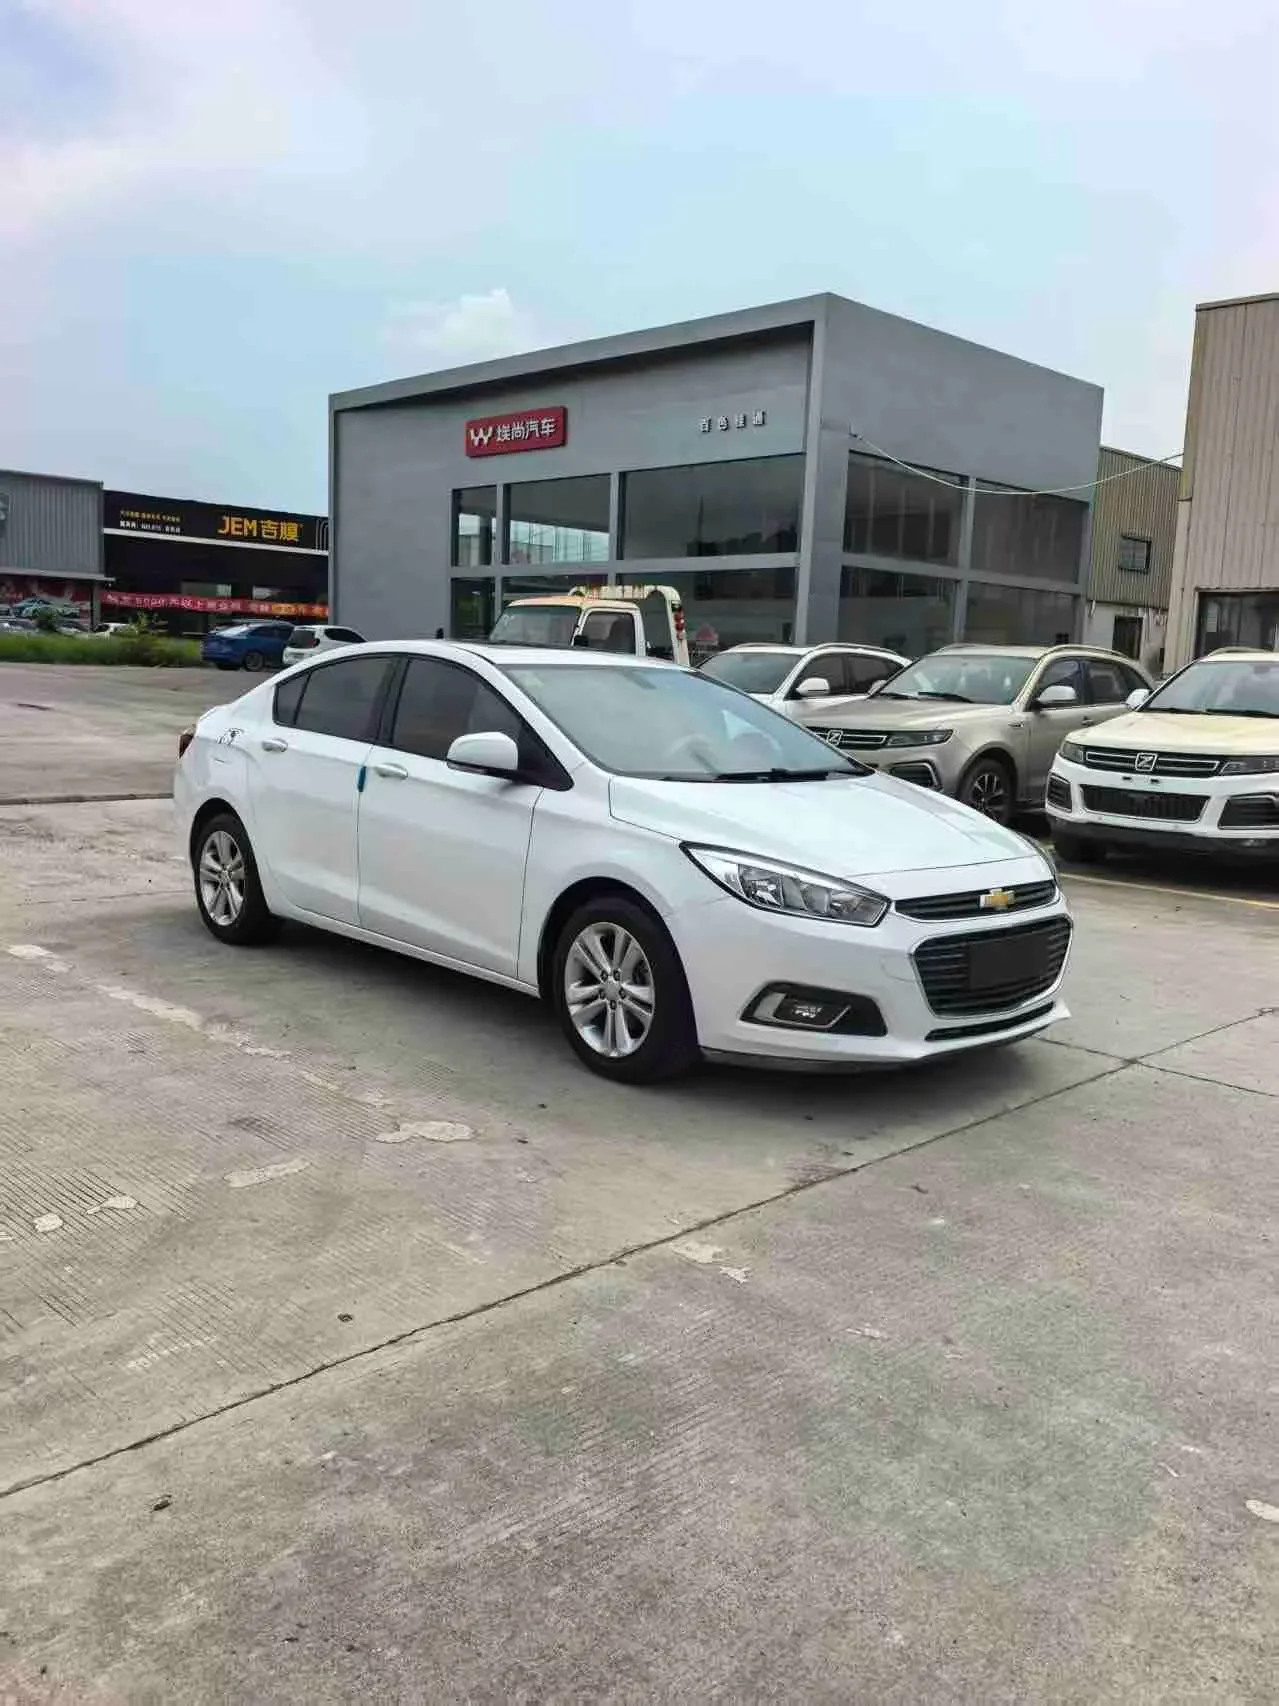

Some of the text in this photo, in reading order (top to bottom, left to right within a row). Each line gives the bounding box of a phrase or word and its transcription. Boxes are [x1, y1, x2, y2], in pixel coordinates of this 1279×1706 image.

[496, 417, 555, 442] 埃尚汽车
[217, 515, 258, 537] JEM
